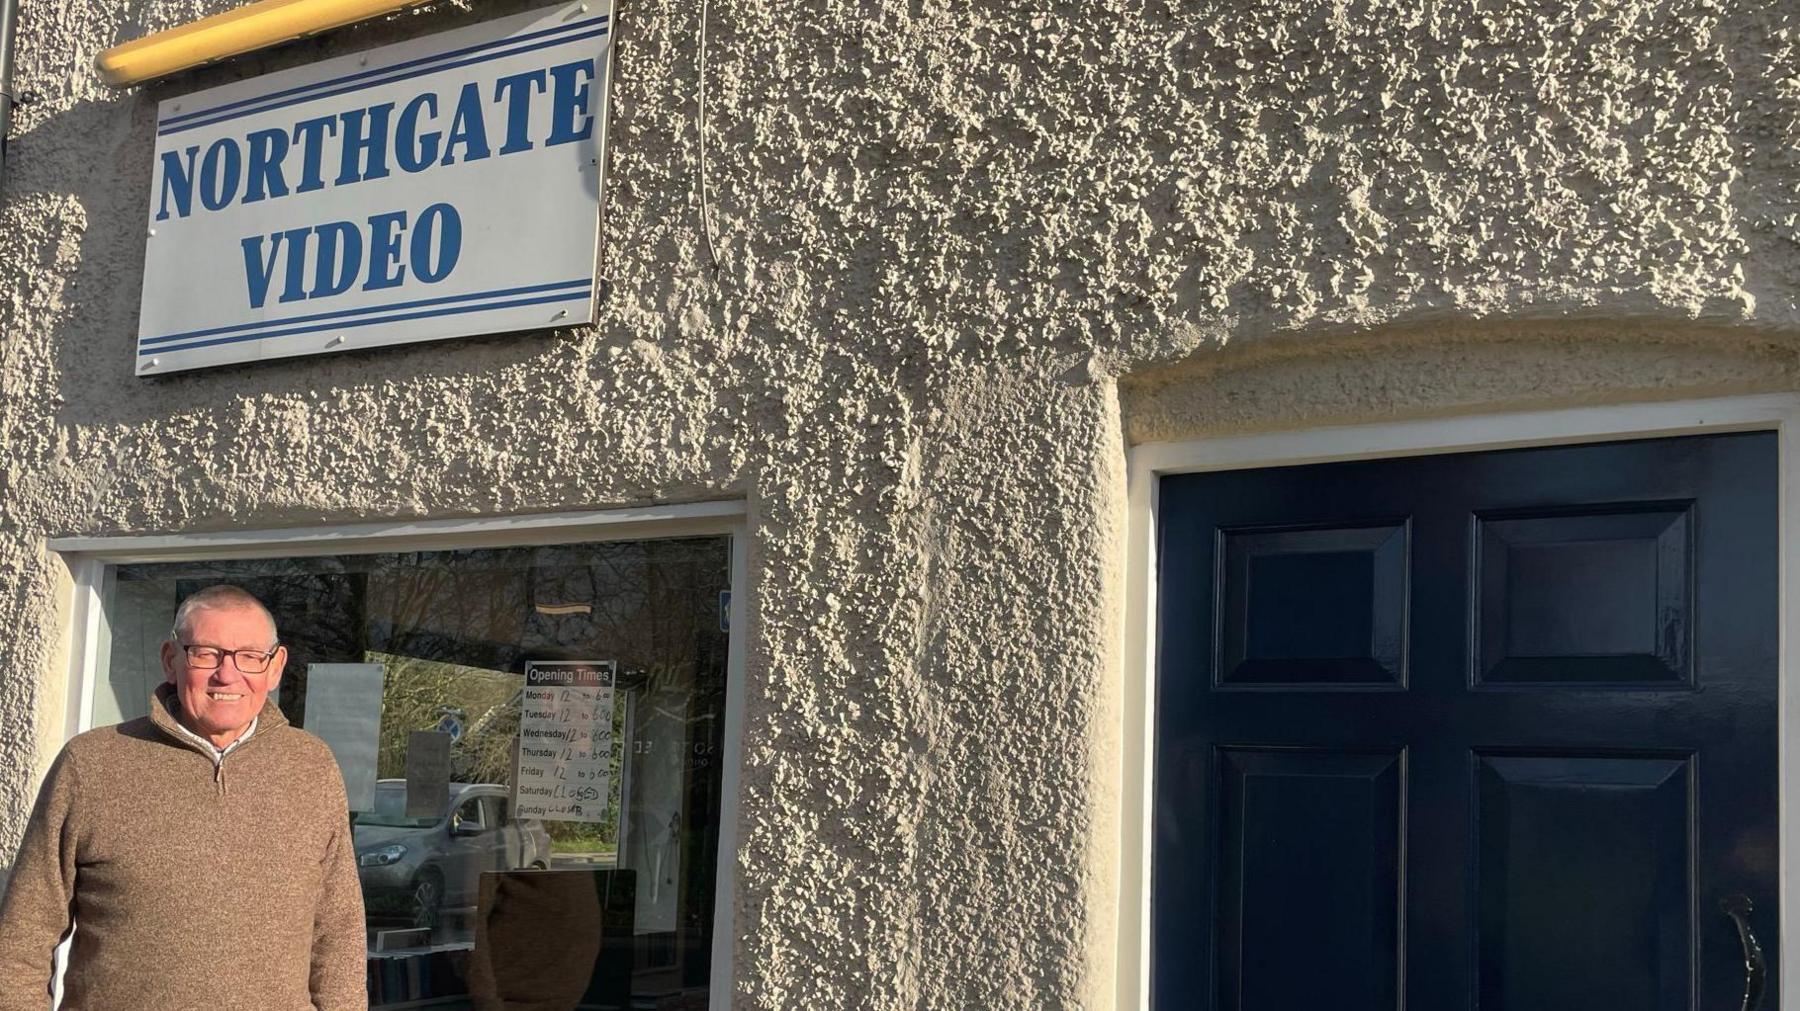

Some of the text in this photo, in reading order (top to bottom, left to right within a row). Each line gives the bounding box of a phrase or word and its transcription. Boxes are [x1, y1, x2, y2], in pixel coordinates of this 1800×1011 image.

[156, 58, 595, 221] NORTHGATE
[240, 202, 463, 309] VIDEO
[529, 668, 609, 684] Opening Times
[526, 690, 554, 702] Monday
[524, 709, 556, 721] Tuesday
[523, 728, 567, 741] Wednesday
[521, 747, 557, 760] Thursday
[520, 766, 544, 778] Friday
[519, 785, 553, 798] Saturday
